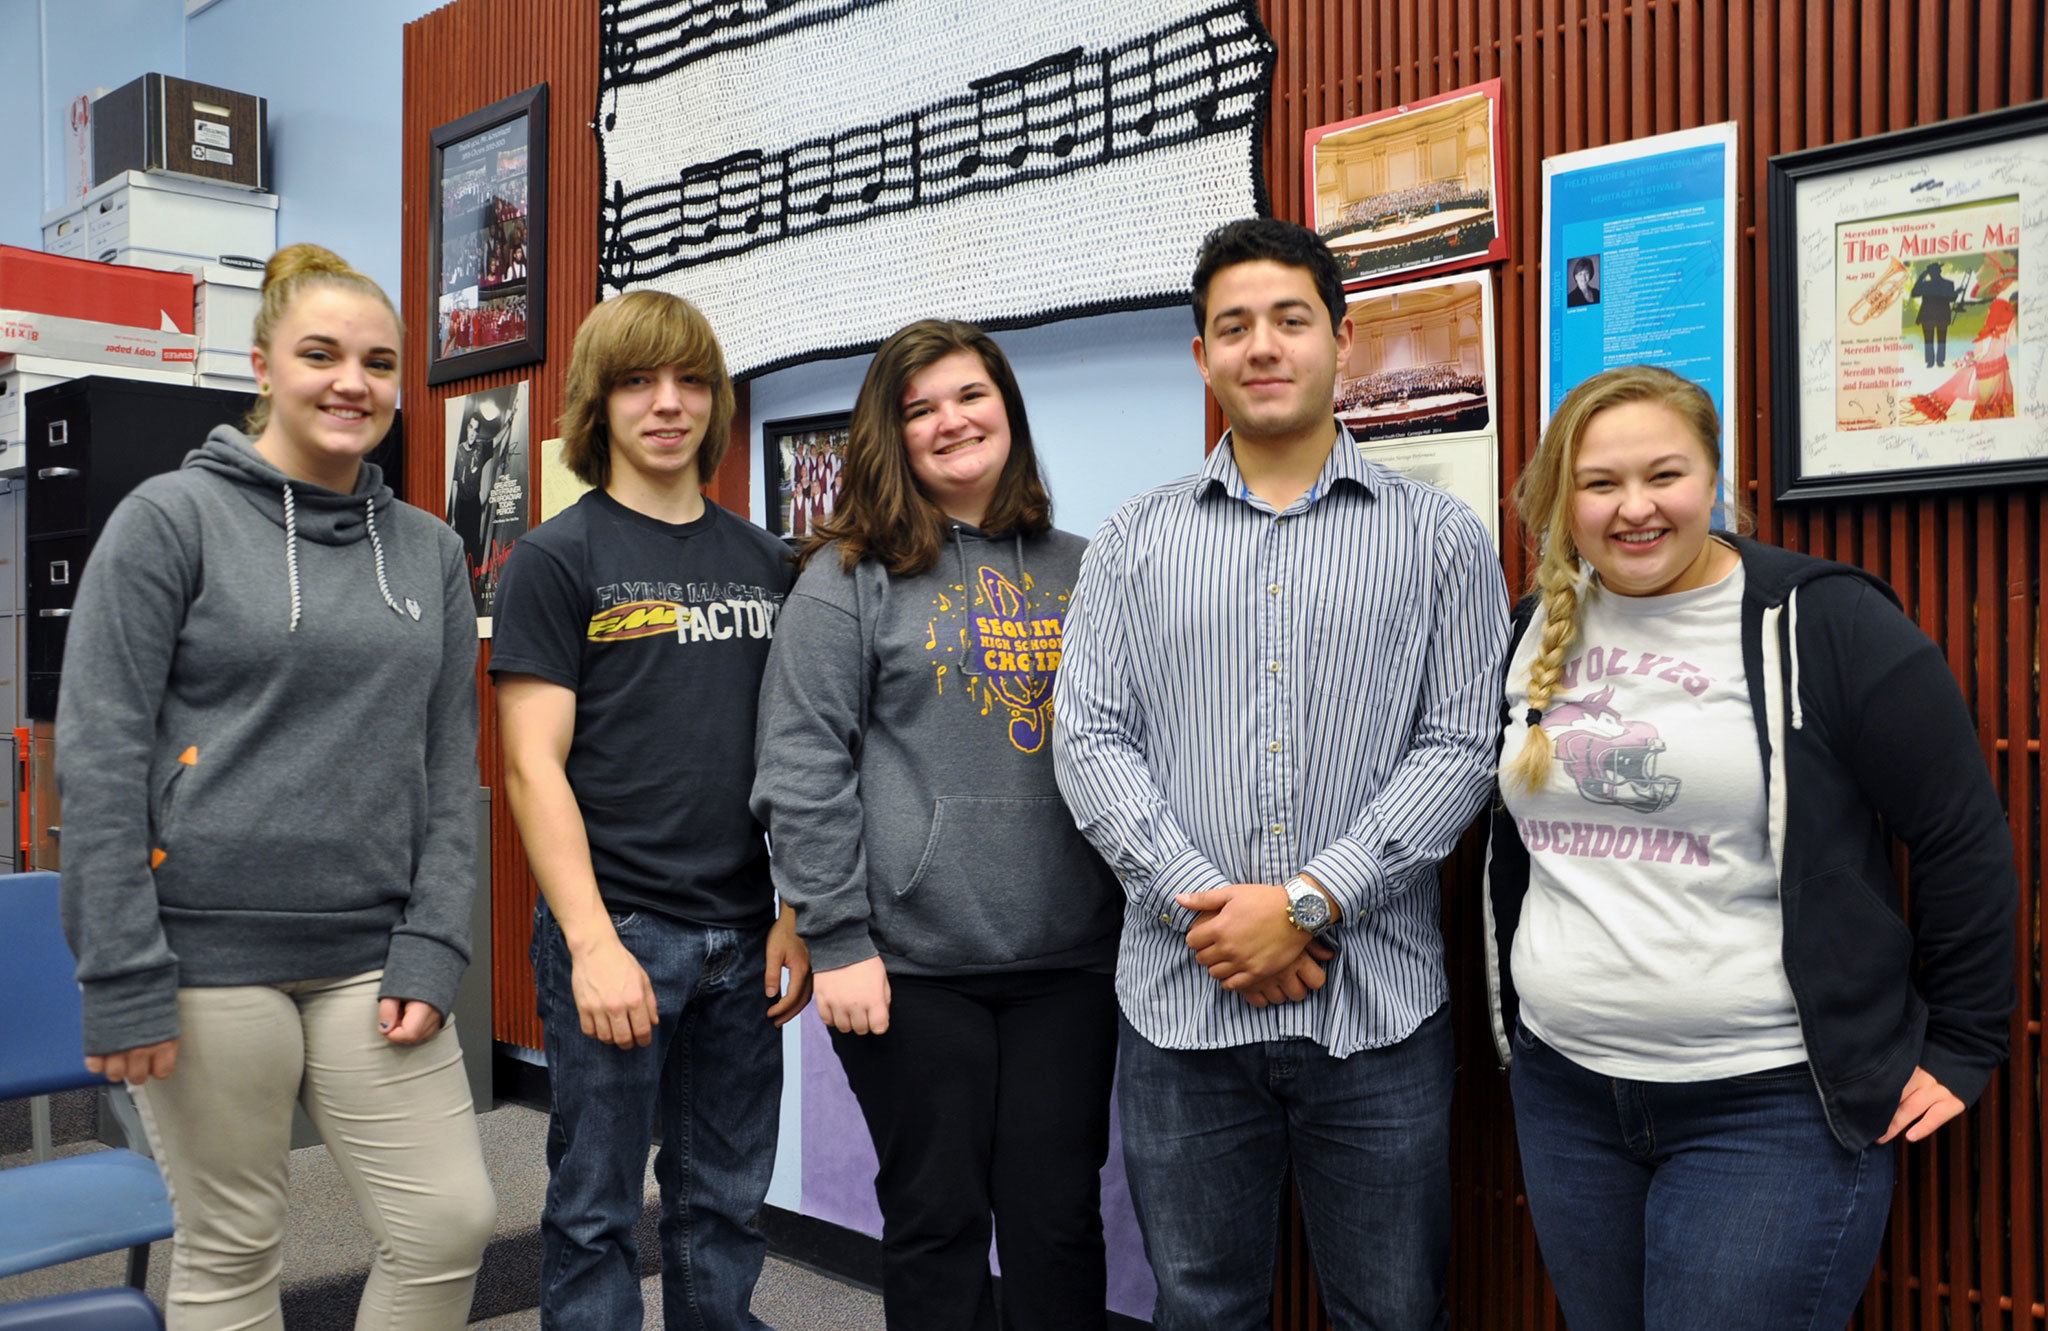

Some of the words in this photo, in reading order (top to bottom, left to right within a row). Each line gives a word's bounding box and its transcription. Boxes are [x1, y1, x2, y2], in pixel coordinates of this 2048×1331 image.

[1843, 227, 1889, 239] Meredith
[1892, 222, 1936, 235] Willson's
[1842, 239, 1890, 264] The
[1899, 228, 1973, 258] Music
[1982, 223, 2020, 248] Ma
[221, 257, 251, 268] BANKERS
[1845, 273, 1859, 282] May
[105, 344, 133, 355] paper
[1551, 328, 1562, 362] enrich
[1844, 344, 1881, 355] Meredith
[1883, 342, 1914, 353] Willson
[134, 346, 156, 358] copy
[163, 351, 193, 360] STAPLES
[1843, 366, 1876, 377] Meredith
[1878, 365, 1905, 376] Willson
[1843, 382, 1857, 391] and
[1858, 379, 1889, 390] Franklin
[1891, 378, 1912, 388] Lacey
[597, 581, 684, 609] FLYING
[980, 635, 1011, 650] HIGH
